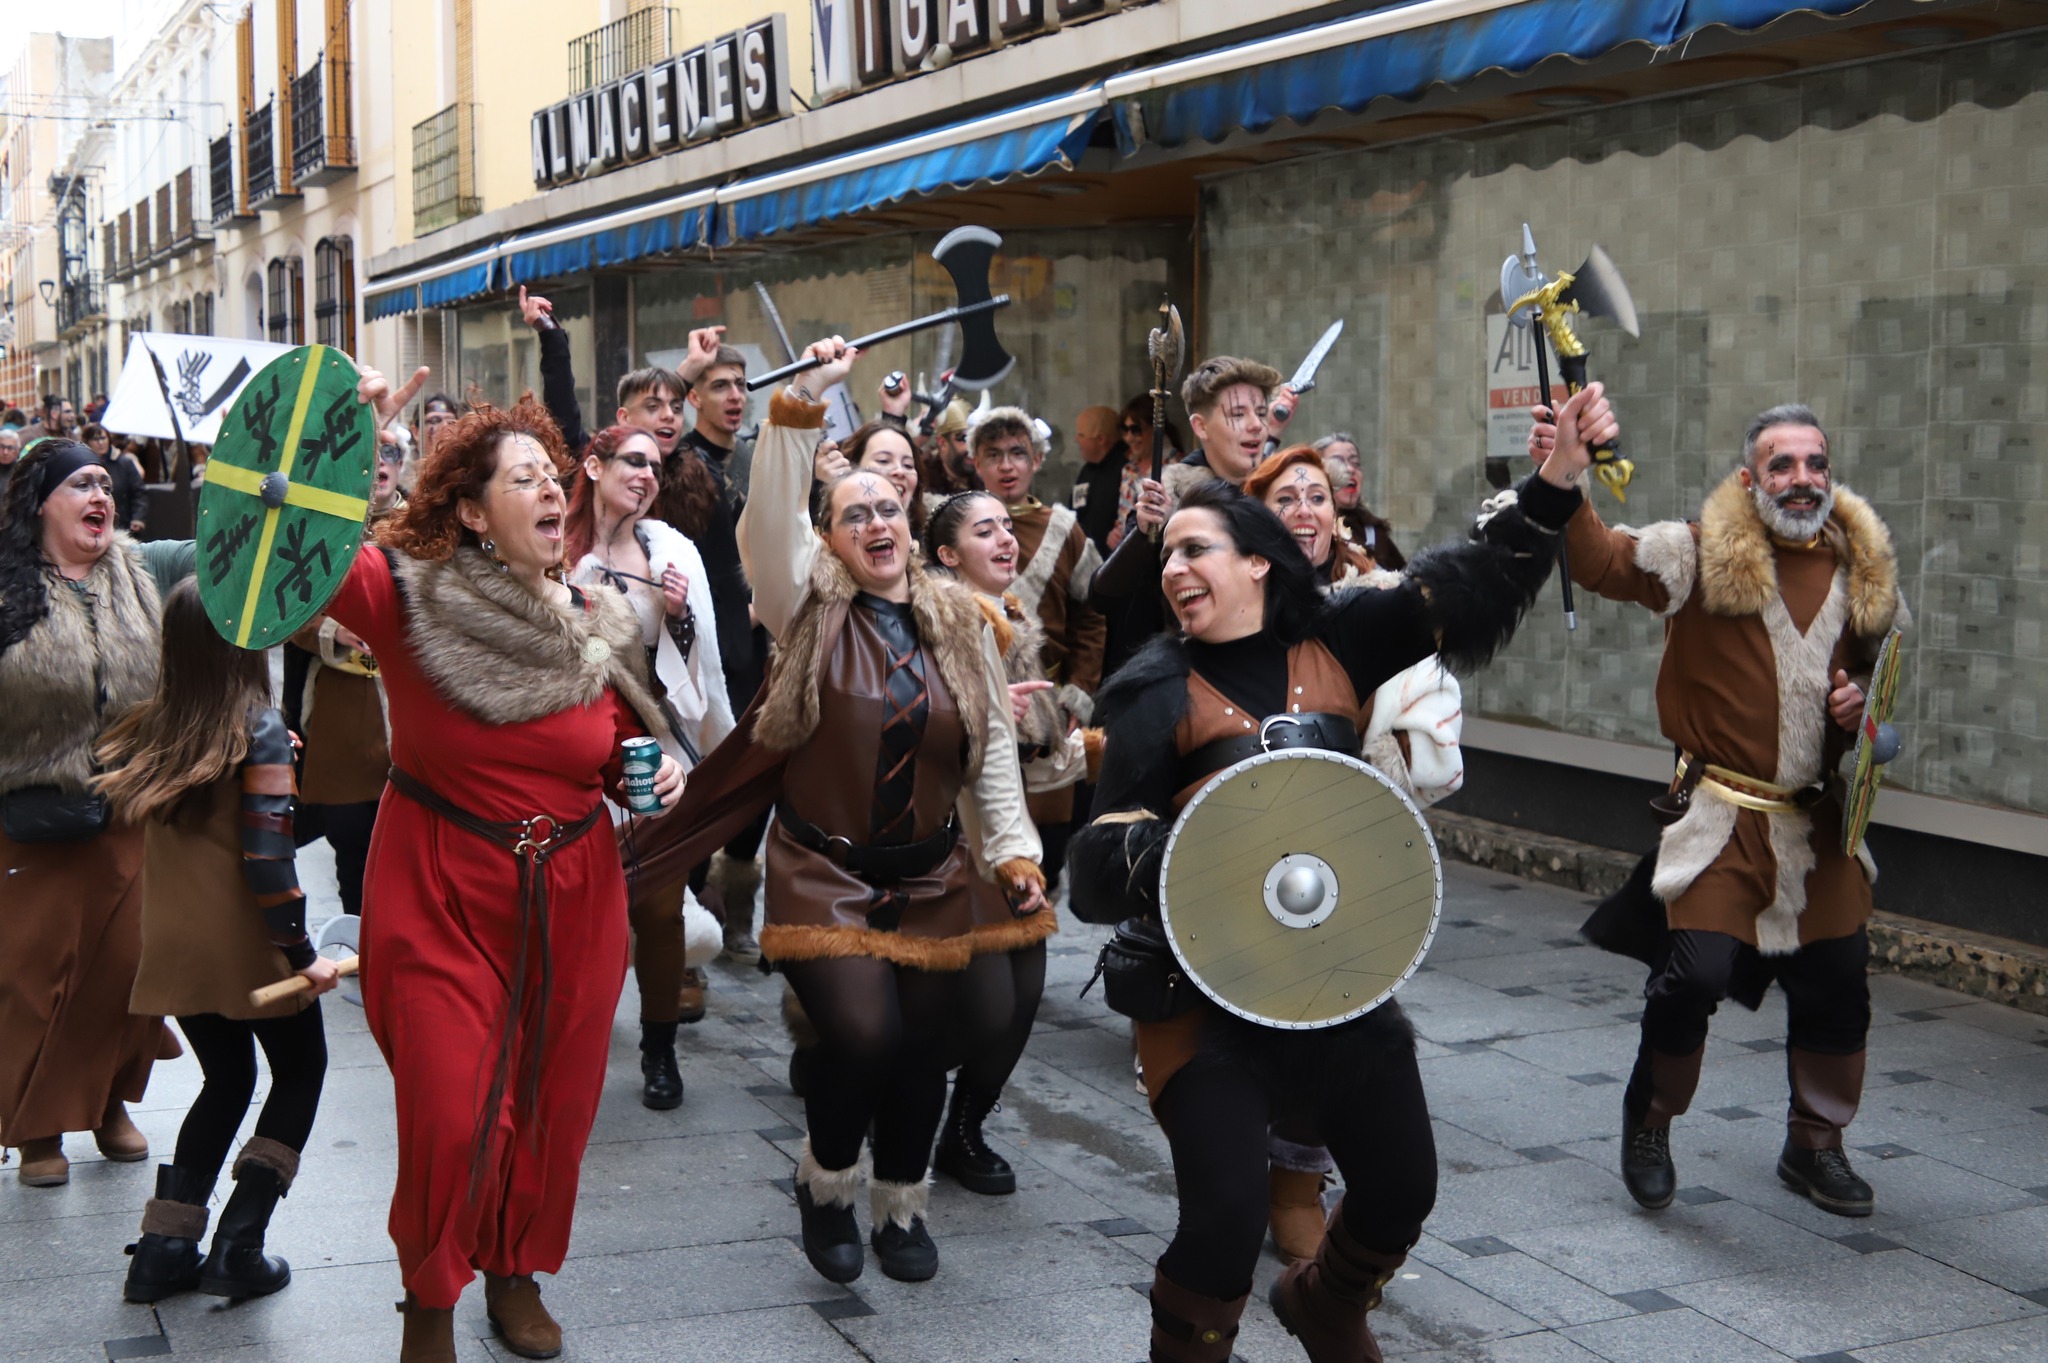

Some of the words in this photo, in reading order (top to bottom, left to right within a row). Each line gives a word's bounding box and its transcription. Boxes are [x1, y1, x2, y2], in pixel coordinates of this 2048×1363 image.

[532, 31, 768, 180] ALMACENES
[815, 0, 1078, 82] VIGA
[1502, 387, 1551, 406] VEND
